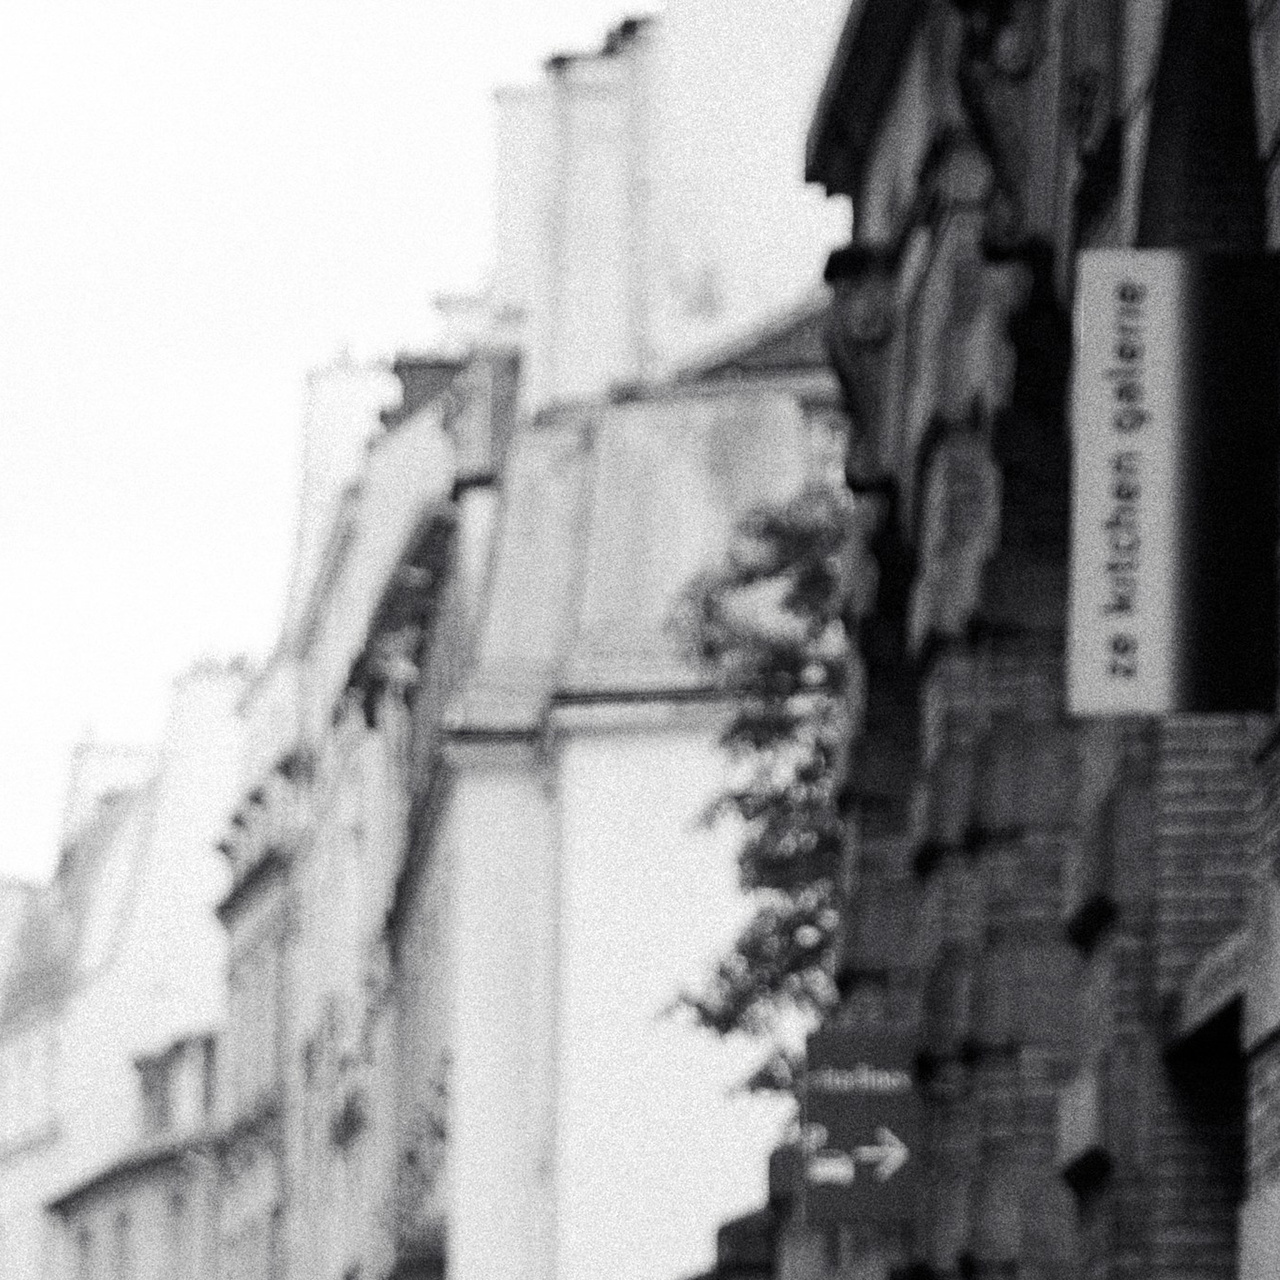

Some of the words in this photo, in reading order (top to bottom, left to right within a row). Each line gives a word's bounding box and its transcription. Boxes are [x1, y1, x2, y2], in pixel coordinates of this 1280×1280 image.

[1101, 281, 1151, 434] galerie
[1100, 452, 1142, 617] kitchen
[1107, 634, 1138, 680] ze
